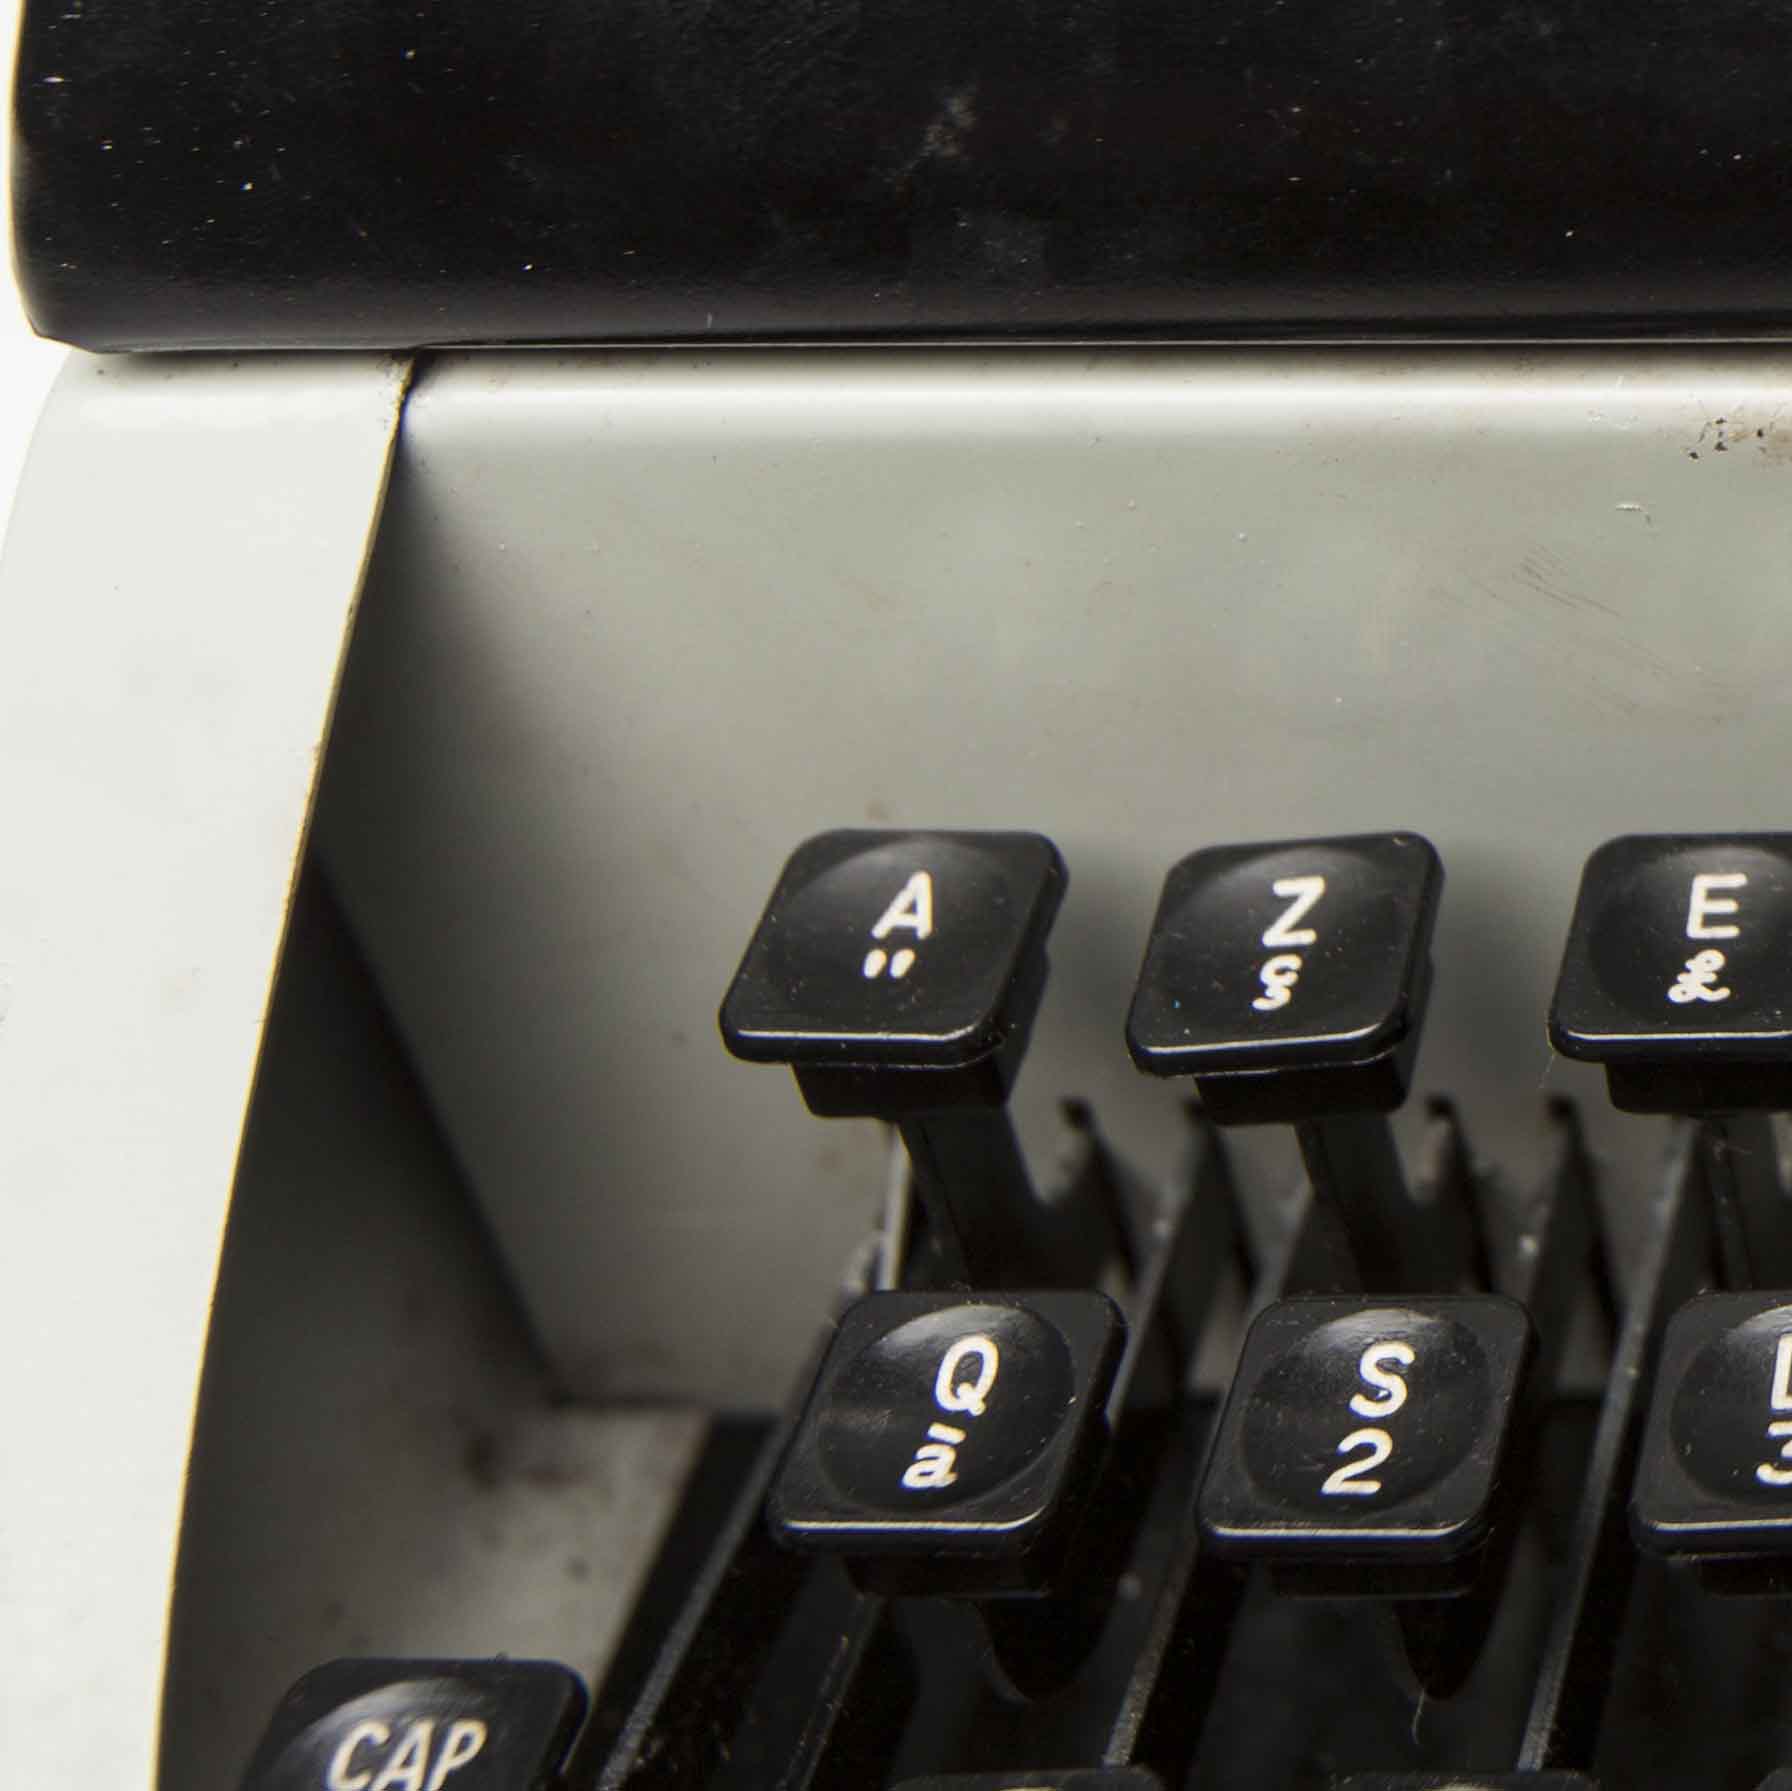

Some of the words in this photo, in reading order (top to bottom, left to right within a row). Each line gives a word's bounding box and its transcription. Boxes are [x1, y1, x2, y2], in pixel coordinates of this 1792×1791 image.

[870, 869, 933, 941] A
[1260, 874, 1326, 949] Z
[1685, 867, 1750, 941] E
[934, 1331, 999, 1417] Q
[1348, 1340, 1416, 1419] S
[1320, 1427, 1394, 1496] 2
[326, 1718, 488, 1791] CAP
